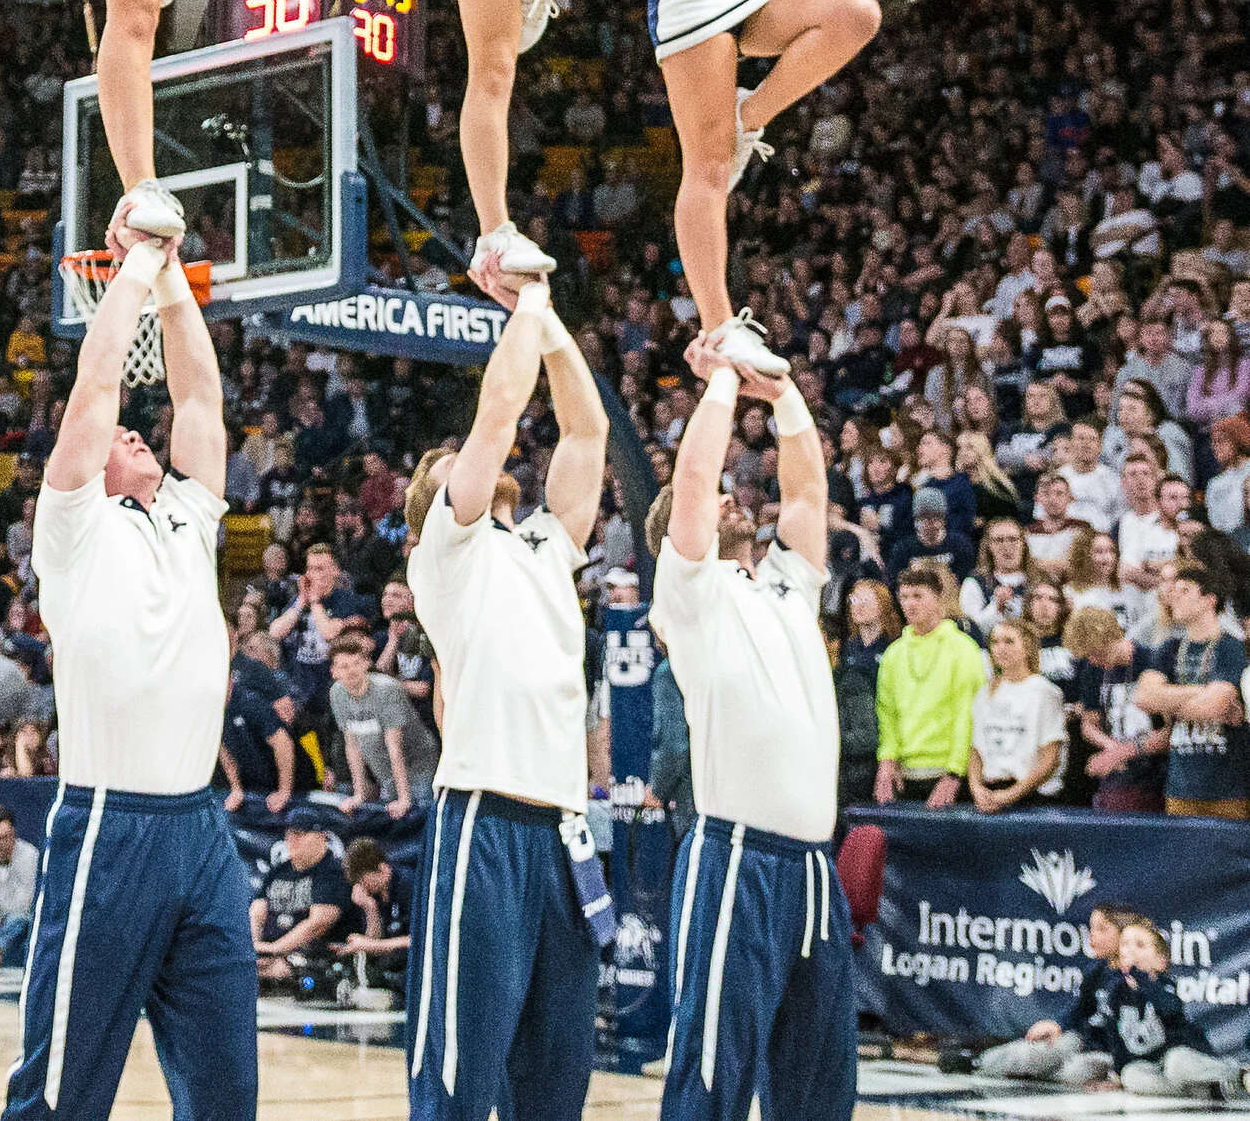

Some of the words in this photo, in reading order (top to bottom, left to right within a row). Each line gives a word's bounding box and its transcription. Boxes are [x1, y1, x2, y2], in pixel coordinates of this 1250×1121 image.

[290, 294, 424, 337] AMERICA
[426, 302, 506, 344] FIRST
[881, 942, 969, 986] Logan
